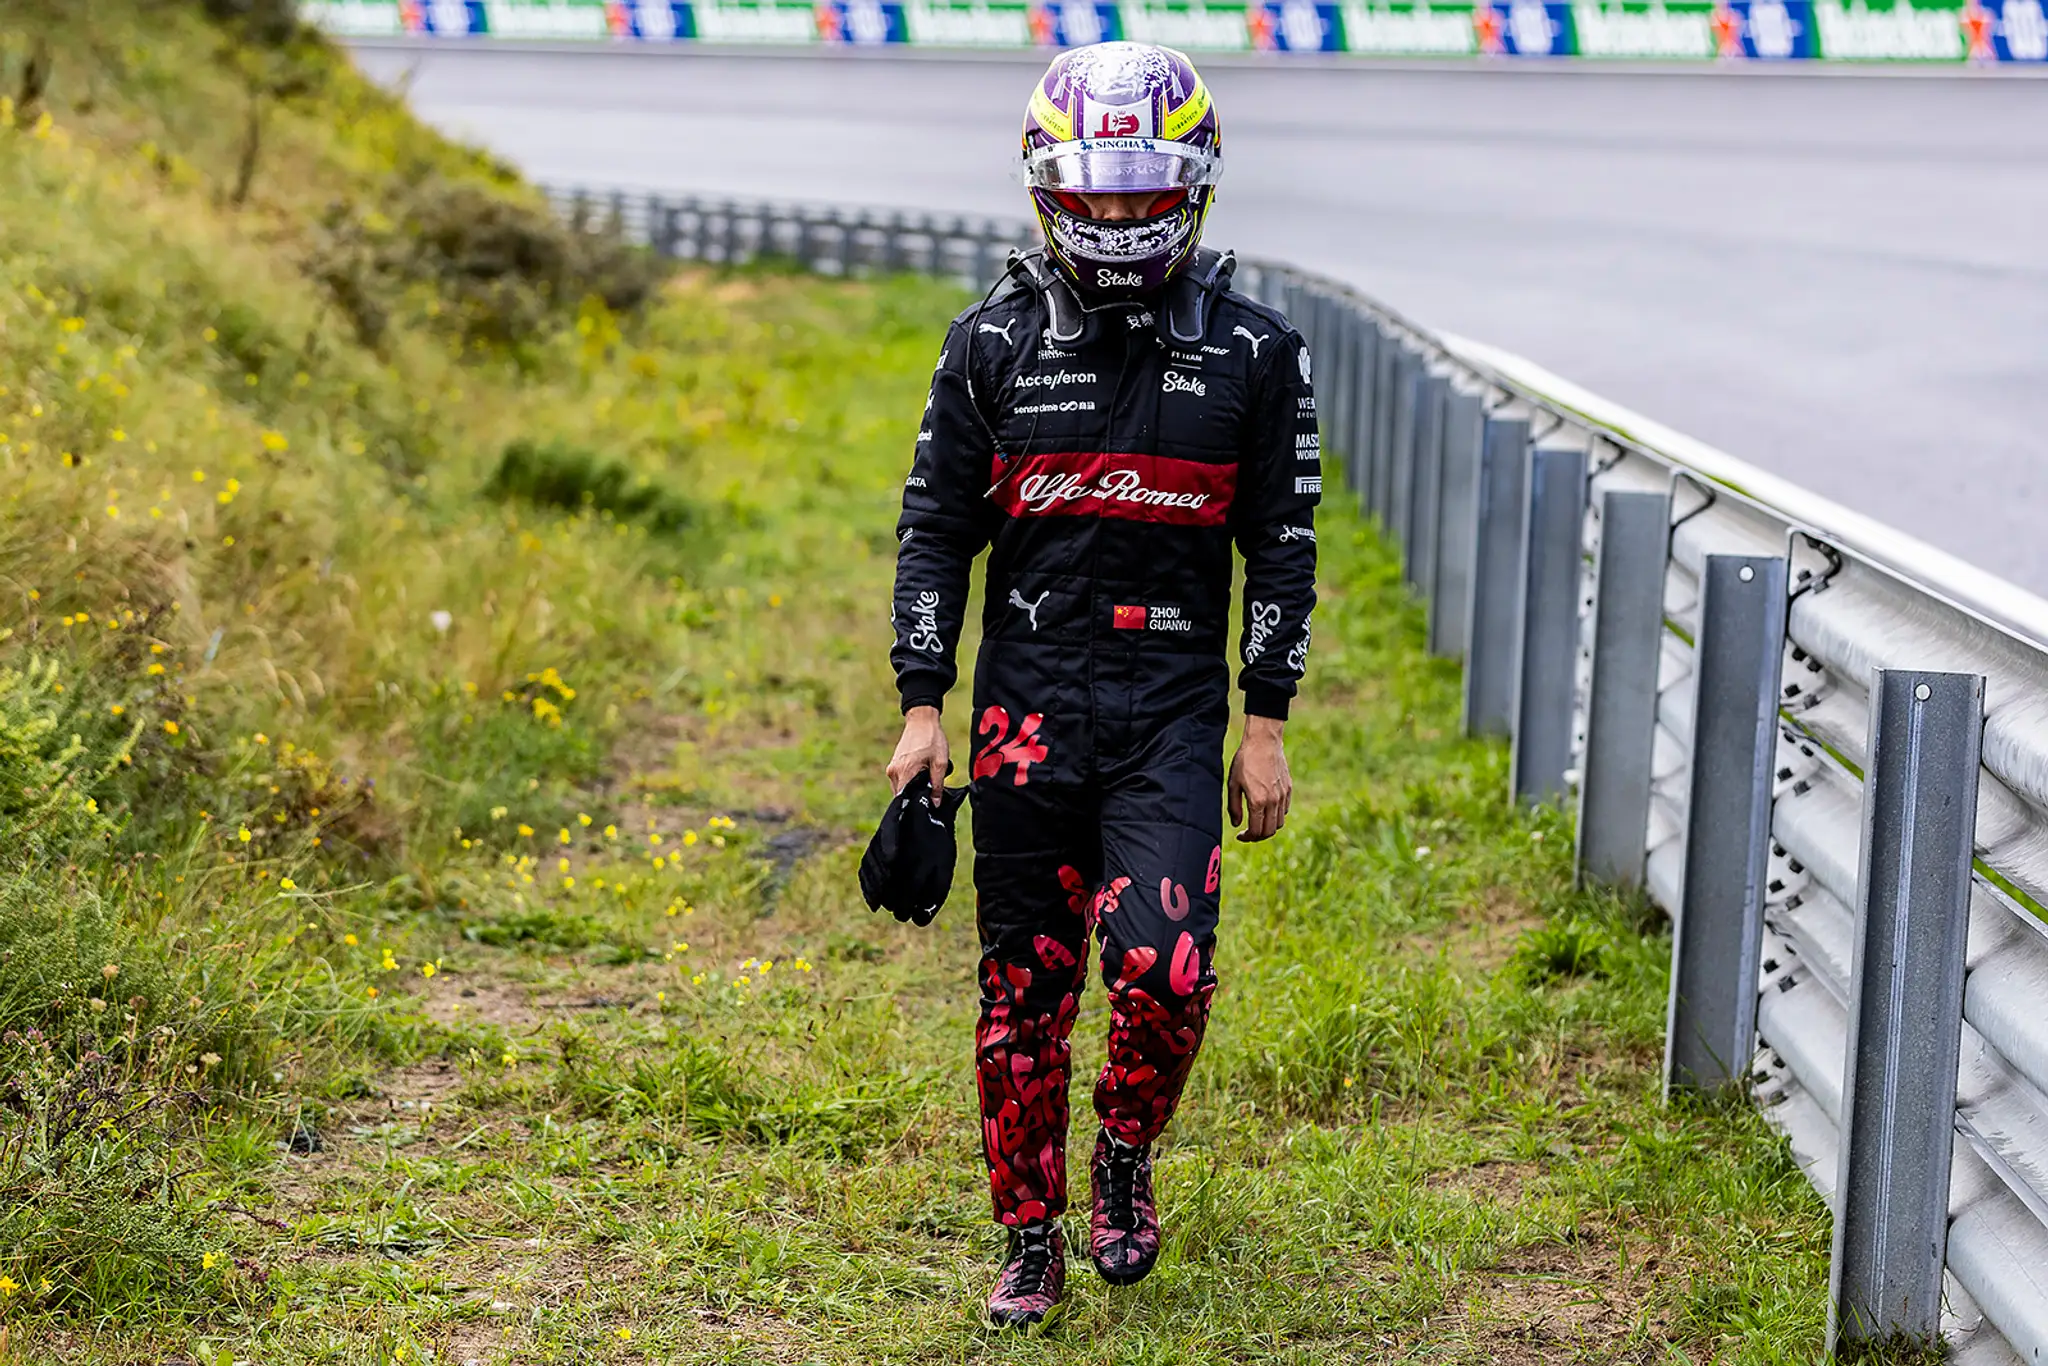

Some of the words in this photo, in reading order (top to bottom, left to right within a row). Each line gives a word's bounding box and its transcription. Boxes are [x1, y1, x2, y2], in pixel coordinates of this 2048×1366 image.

[1095, 140, 1140, 149] SINGHA
[1096, 268, 1143, 287] Stake
[1162, 371, 1207, 397] Stake
[1020, 473, 1093, 512] Alfa
[1092, 469, 1210, 510] Romeo
[909, 590, 944, 653] Stake
[1150, 606, 1181, 619] ZHOU
[1149, 618, 1192, 631] GUANYU
[973, 705, 1049, 786] 24
